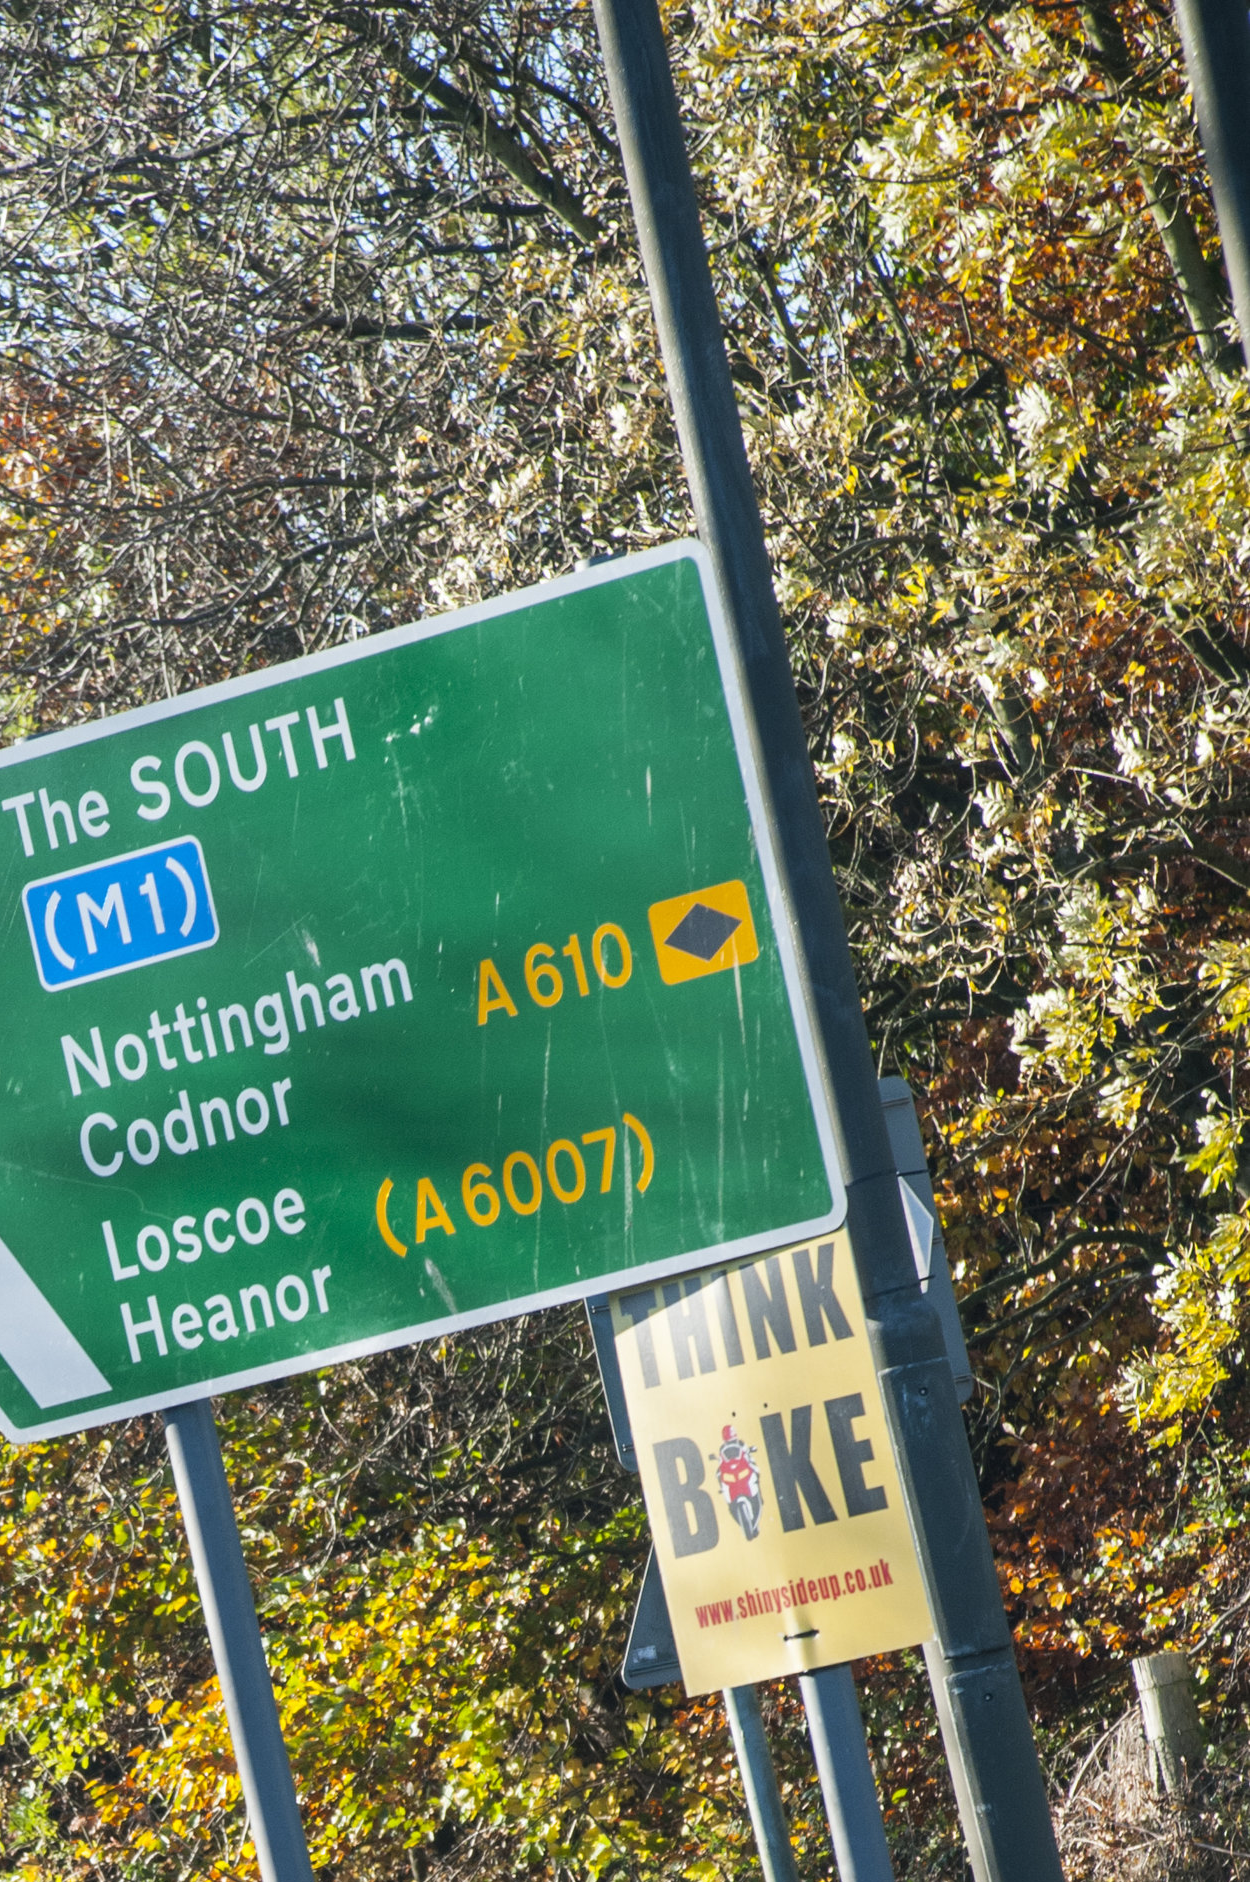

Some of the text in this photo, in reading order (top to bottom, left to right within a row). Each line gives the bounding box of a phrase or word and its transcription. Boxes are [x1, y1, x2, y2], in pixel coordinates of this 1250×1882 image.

[0, 697, 357, 858] The SOUTH
[43, 857, 198, 970] (M1)
[60, 957, 414, 1097] Nottingham
[478, 923, 633, 1025] A610
[79, 1077, 292, 1177] Codnor
[101, 1187, 307, 1282] Loscoe
[374, 1113, 654, 1257] (A6007)
[119, 1265, 332, 1364] Heanor
[618, 1242, 855, 1389] THINK
[695, 1558, 894, 1629] www.shinysideup.co.uk
